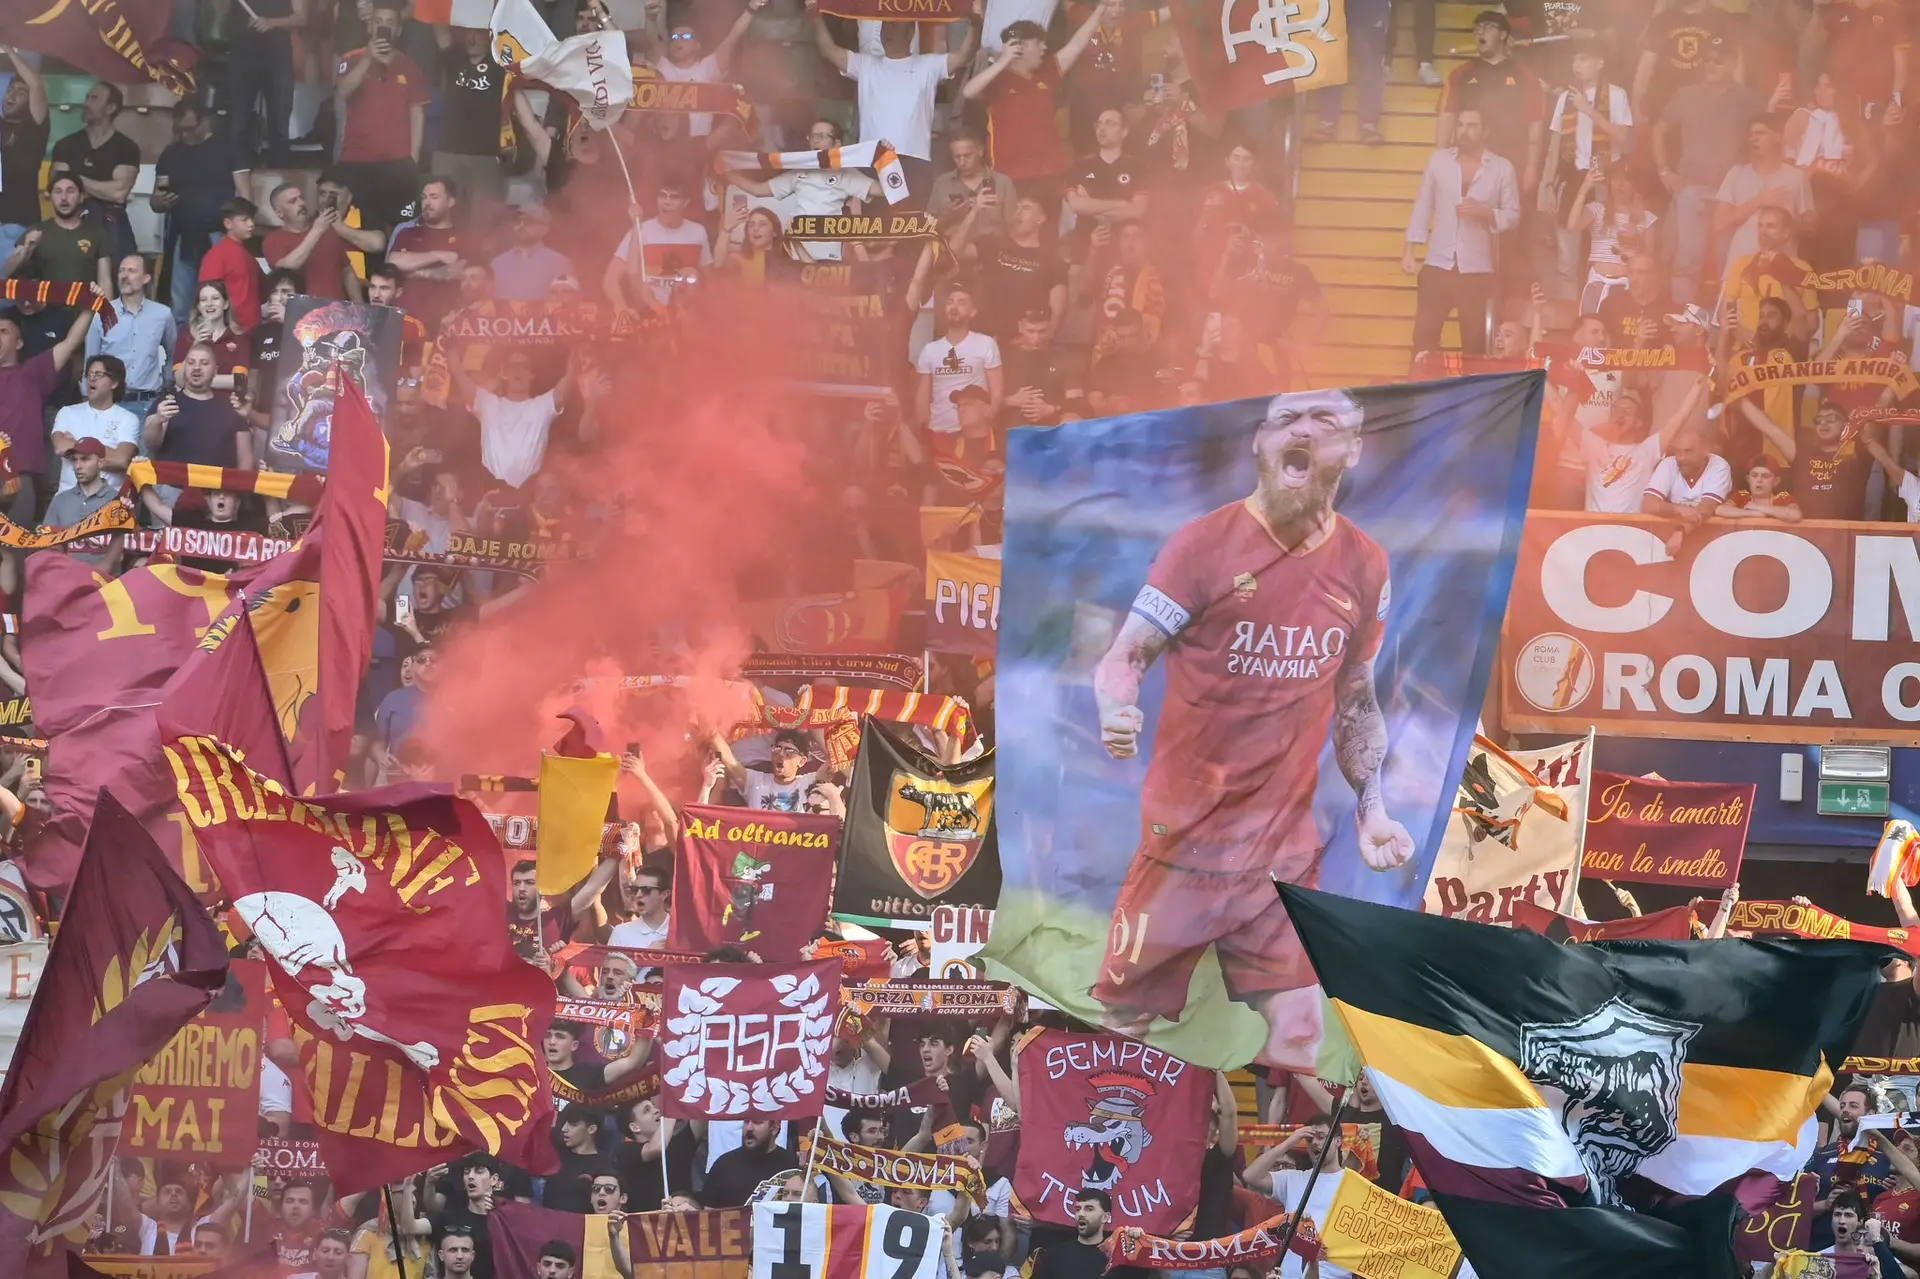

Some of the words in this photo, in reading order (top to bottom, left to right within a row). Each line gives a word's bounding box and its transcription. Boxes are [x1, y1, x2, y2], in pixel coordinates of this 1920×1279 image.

[823, 217, 884, 234] ROMA
[1754, 361, 1839, 382] GRANDE
[165, 531, 181, 551] IO
[185, 532, 232, 556] SONO
[235, 537, 258, 560] LA
[450, 536, 500, 557] DAJE
[1533, 655, 1556, 664] CLUB
[1534, 645, 1560, 654] ROMA
[837, 658, 872, 669] Curva
[876, 659, 900, 673] Sud
[1602, 652, 1852, 719] ROMA
[1639, 792, 1664, 823] di
[1669, 796, 1744, 826] amarti
[684, 818, 721, 840] Ad
[727, 823, 830, 849] oltranza
[1629, 842, 1656, 873] la
[1658, 848, 1728, 878] smetto
[850, 991, 916, 1005] FORZA
[941, 991, 1001, 1006] ROMA
[913, 983, 963, 991] NUMBER
[562, 1003, 632, 1023] ROMA
[881, 1006, 918, 1014] MAGICA
[1046, 1040, 1187, 1087] SEMPER
[851, 1086, 912, 1108] ROMA
[130, 1094, 226, 1154] MAI
[257, 1148, 327, 1169] ROM
[820, 1143, 854, 1173] AS
[873, 1153, 956, 1185] ROMA
[1038, 1171, 1173, 1224] TEUM
[1363, 1185, 1448, 1242] FEDELE
[640, 1209, 743, 1259] VALE
[1149, 1228, 1277, 1262] ROMA
[1295, 1232, 1318, 1246] ROMA
[1334, 1204, 1455, 1275] COMPAGNA
[1151, 1258, 1209, 1268] CAPUT
[1217, 1249, 1277, 1267] MUNDI
[1356, 1248, 1406, 1279] MIA
